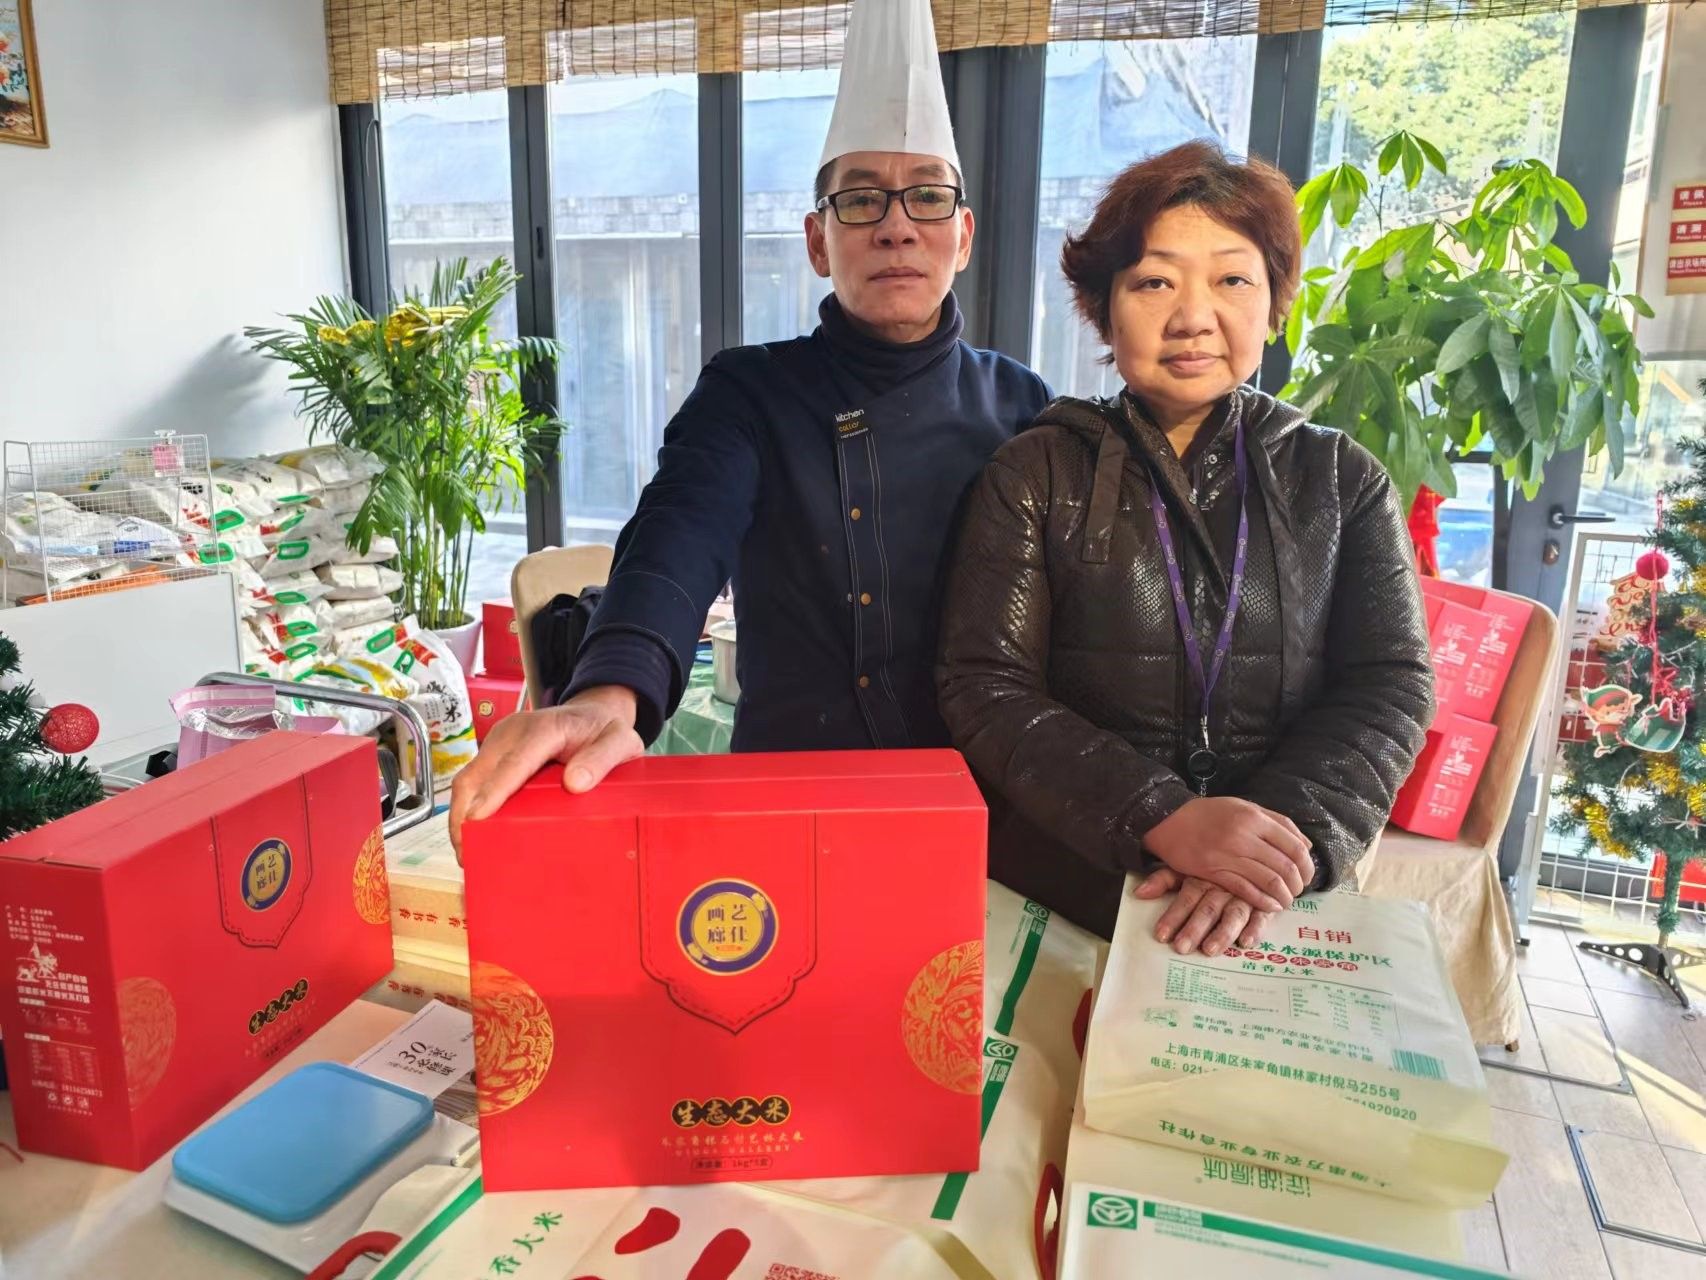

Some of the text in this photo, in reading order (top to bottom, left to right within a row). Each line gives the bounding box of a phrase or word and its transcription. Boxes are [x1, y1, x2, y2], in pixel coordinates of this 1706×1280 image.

[835, 409, 864, 422] kitchen
[1298, 926, 1352, 944] 自销
[399, 1041, 427, 1064] 30
[675, 1097, 787, 1127] 生态大米
[484, 1212, 563, 1280] 香大米
